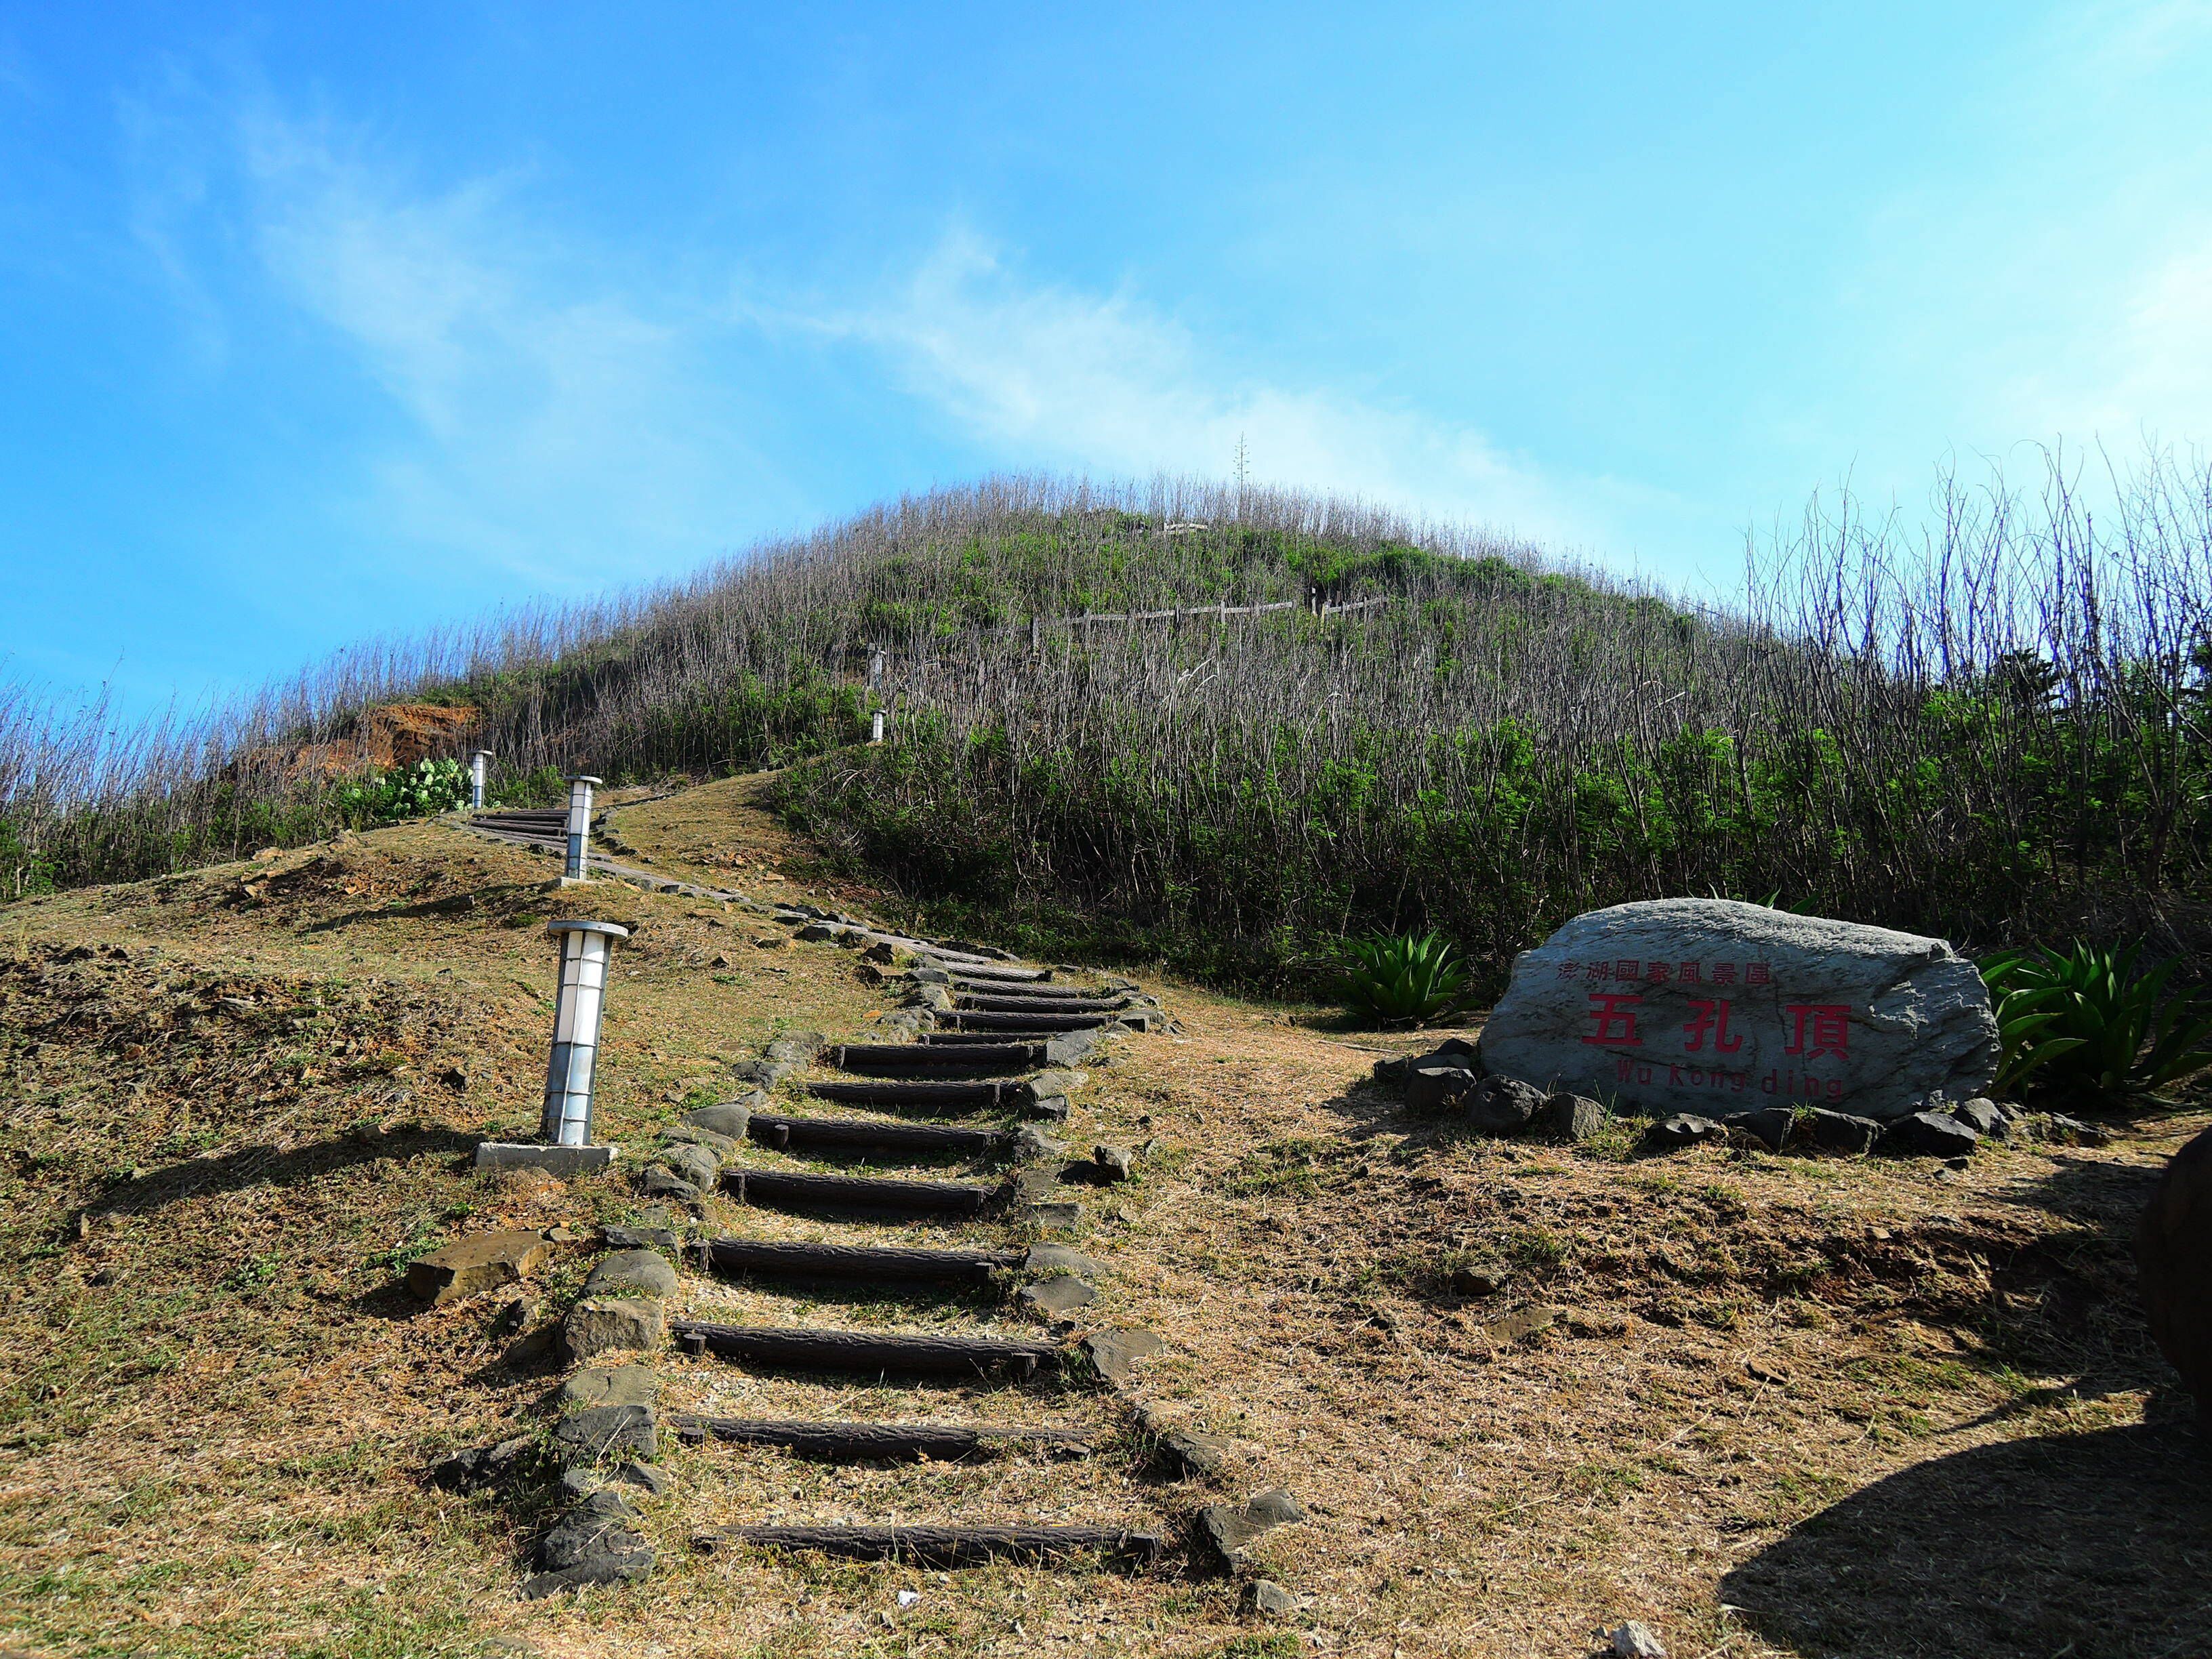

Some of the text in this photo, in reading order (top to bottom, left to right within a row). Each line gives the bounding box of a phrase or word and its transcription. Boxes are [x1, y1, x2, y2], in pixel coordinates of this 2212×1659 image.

[1555, 959, 1771, 985] 澎湖國家風景區
[1581, 994, 1852, 1060] 五孔頂
[1617, 1059, 1652, 1085] Wu
[1763, 1068, 1843, 1102] ding
